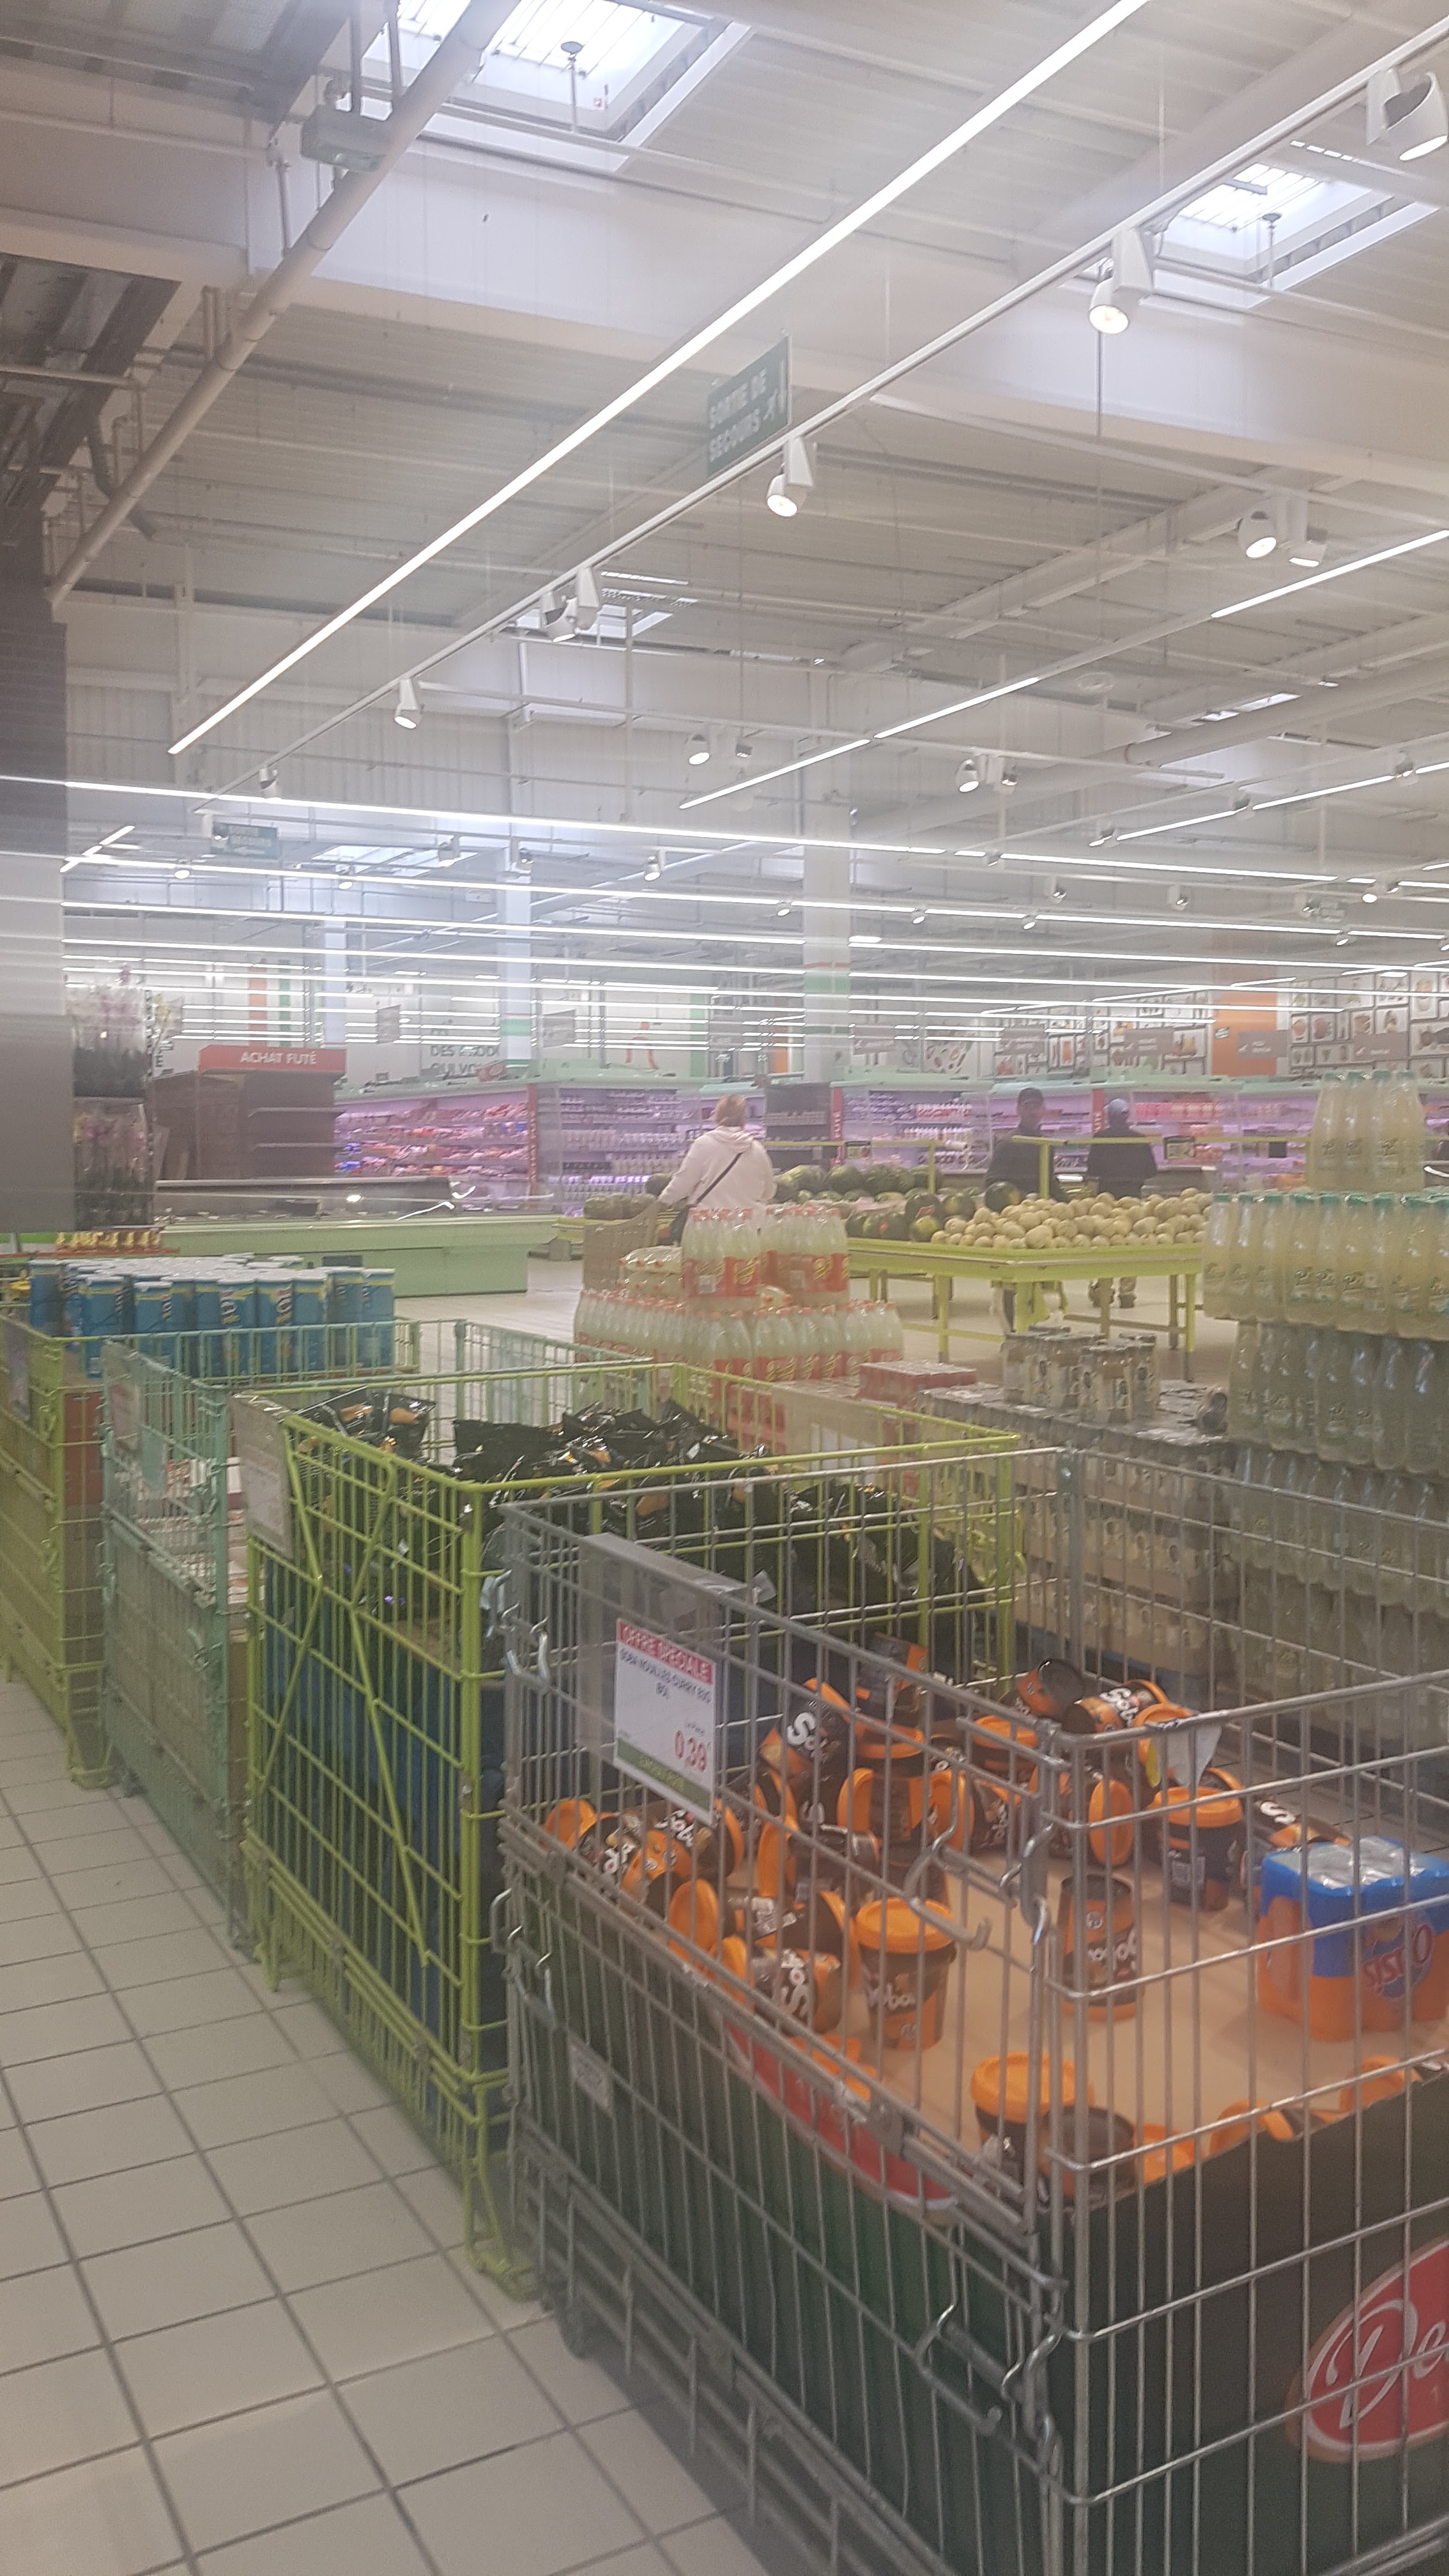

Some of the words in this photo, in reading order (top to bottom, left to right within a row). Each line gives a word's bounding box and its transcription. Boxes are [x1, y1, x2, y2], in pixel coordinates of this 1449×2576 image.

[240, 1052, 284, 1064] ACHAT
[287, 1050, 318, 1065] FUTÉ
[1326, 2298, 1449, 2430] De
